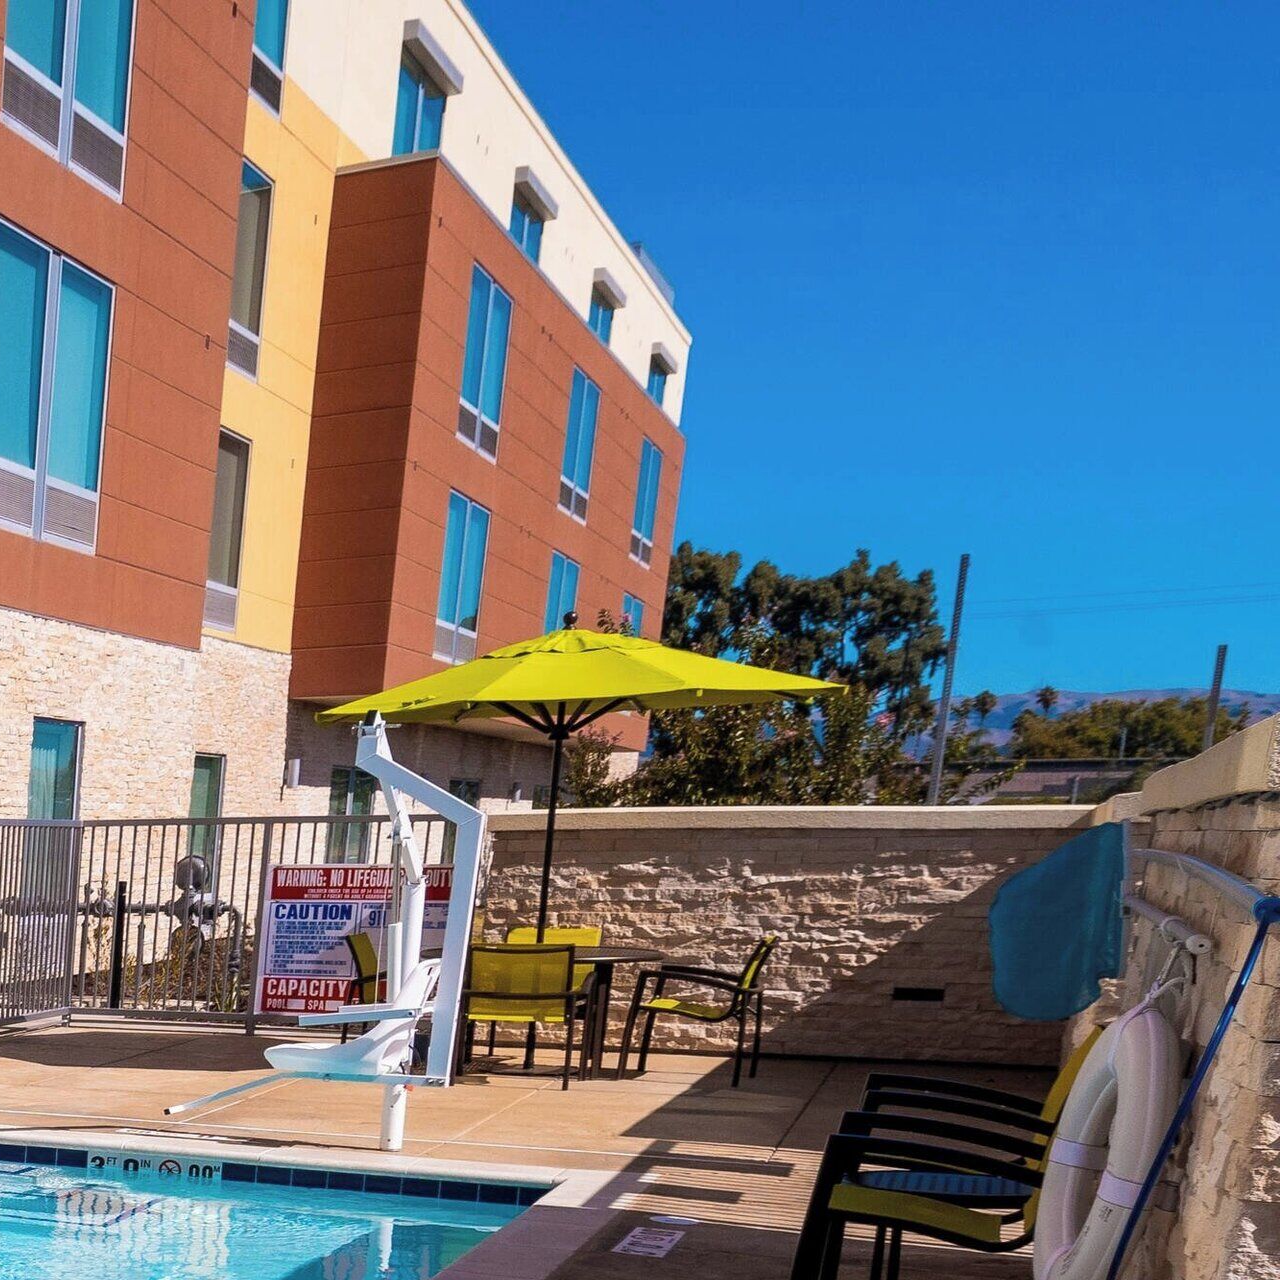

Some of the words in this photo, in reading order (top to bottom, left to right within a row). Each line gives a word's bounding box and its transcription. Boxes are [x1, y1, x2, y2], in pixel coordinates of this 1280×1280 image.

[277, 869, 327, 887] WARNING:
[330, 869, 345, 887] NO
[275, 904, 353, 920] CAUTION
[267, 979, 348, 997] CAPACITY
[267, 998, 286, 1009] POOL
[307, 1000, 324, 1010] SPA
